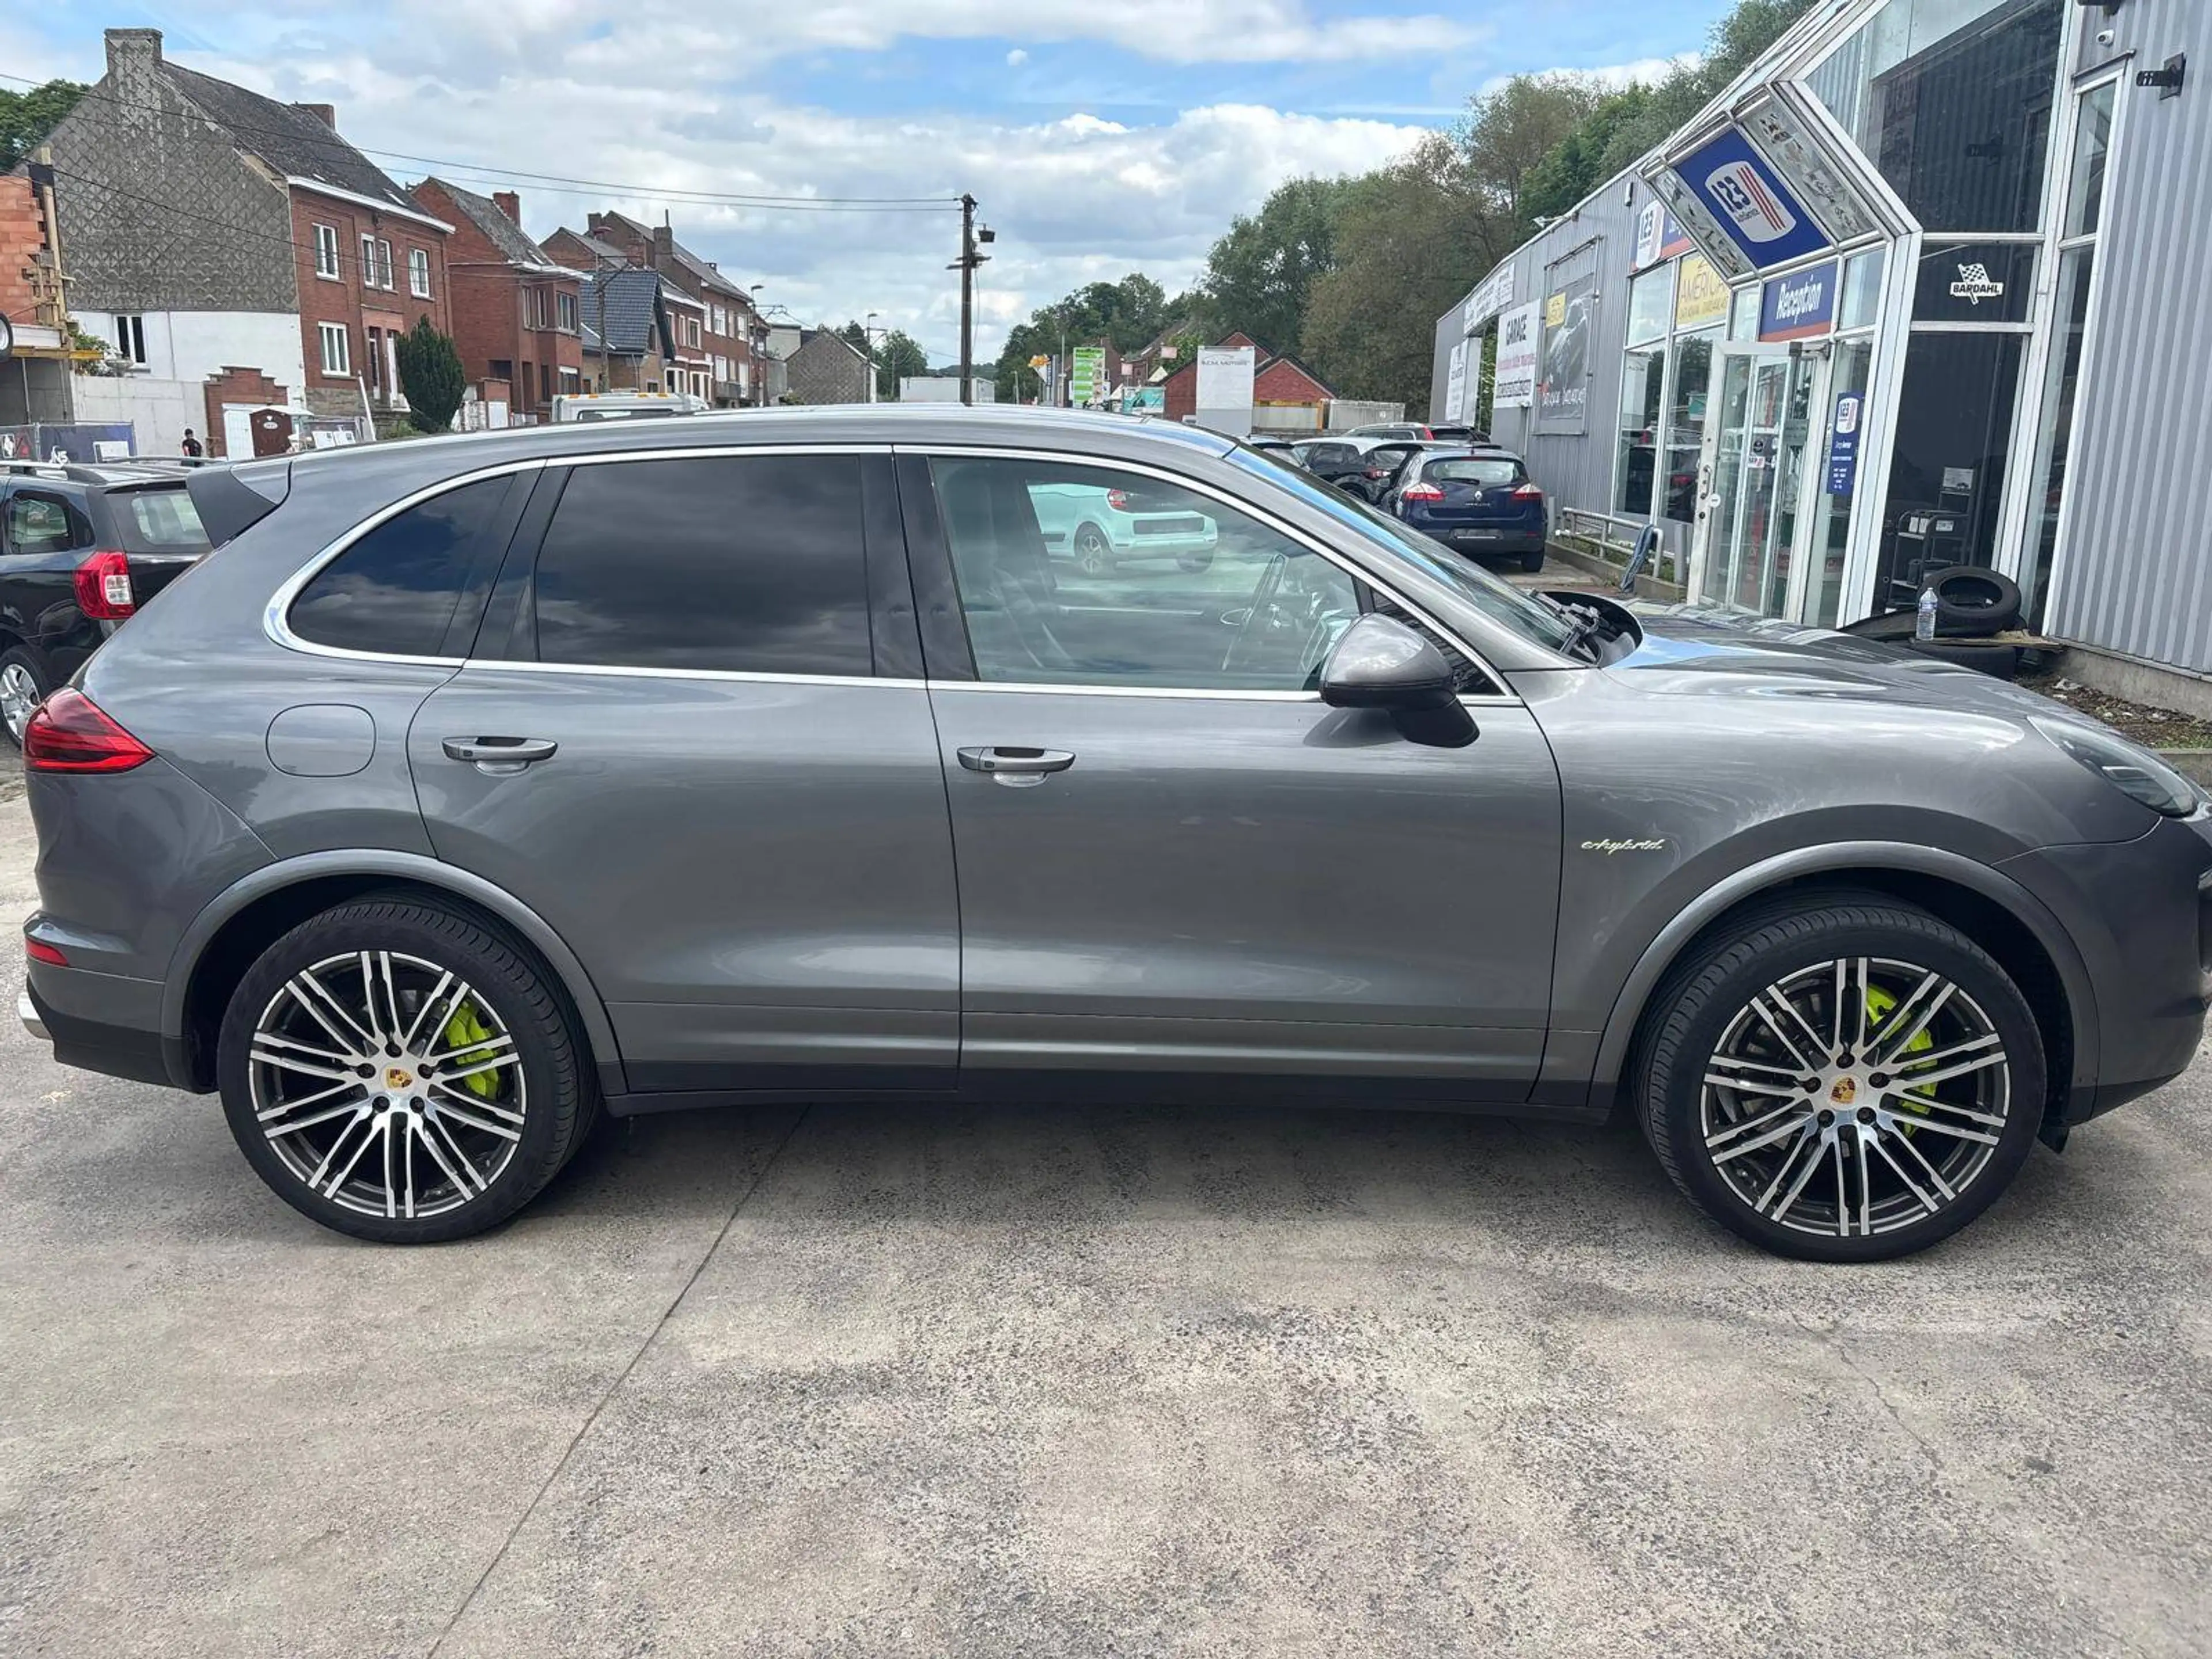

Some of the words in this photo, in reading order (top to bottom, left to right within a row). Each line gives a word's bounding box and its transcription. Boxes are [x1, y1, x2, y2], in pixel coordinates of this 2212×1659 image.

[1711, 176, 1751, 213] 123
[1776, 274, 1822, 325] Réception
[1953, 285, 1999, 293] BARDAHL
